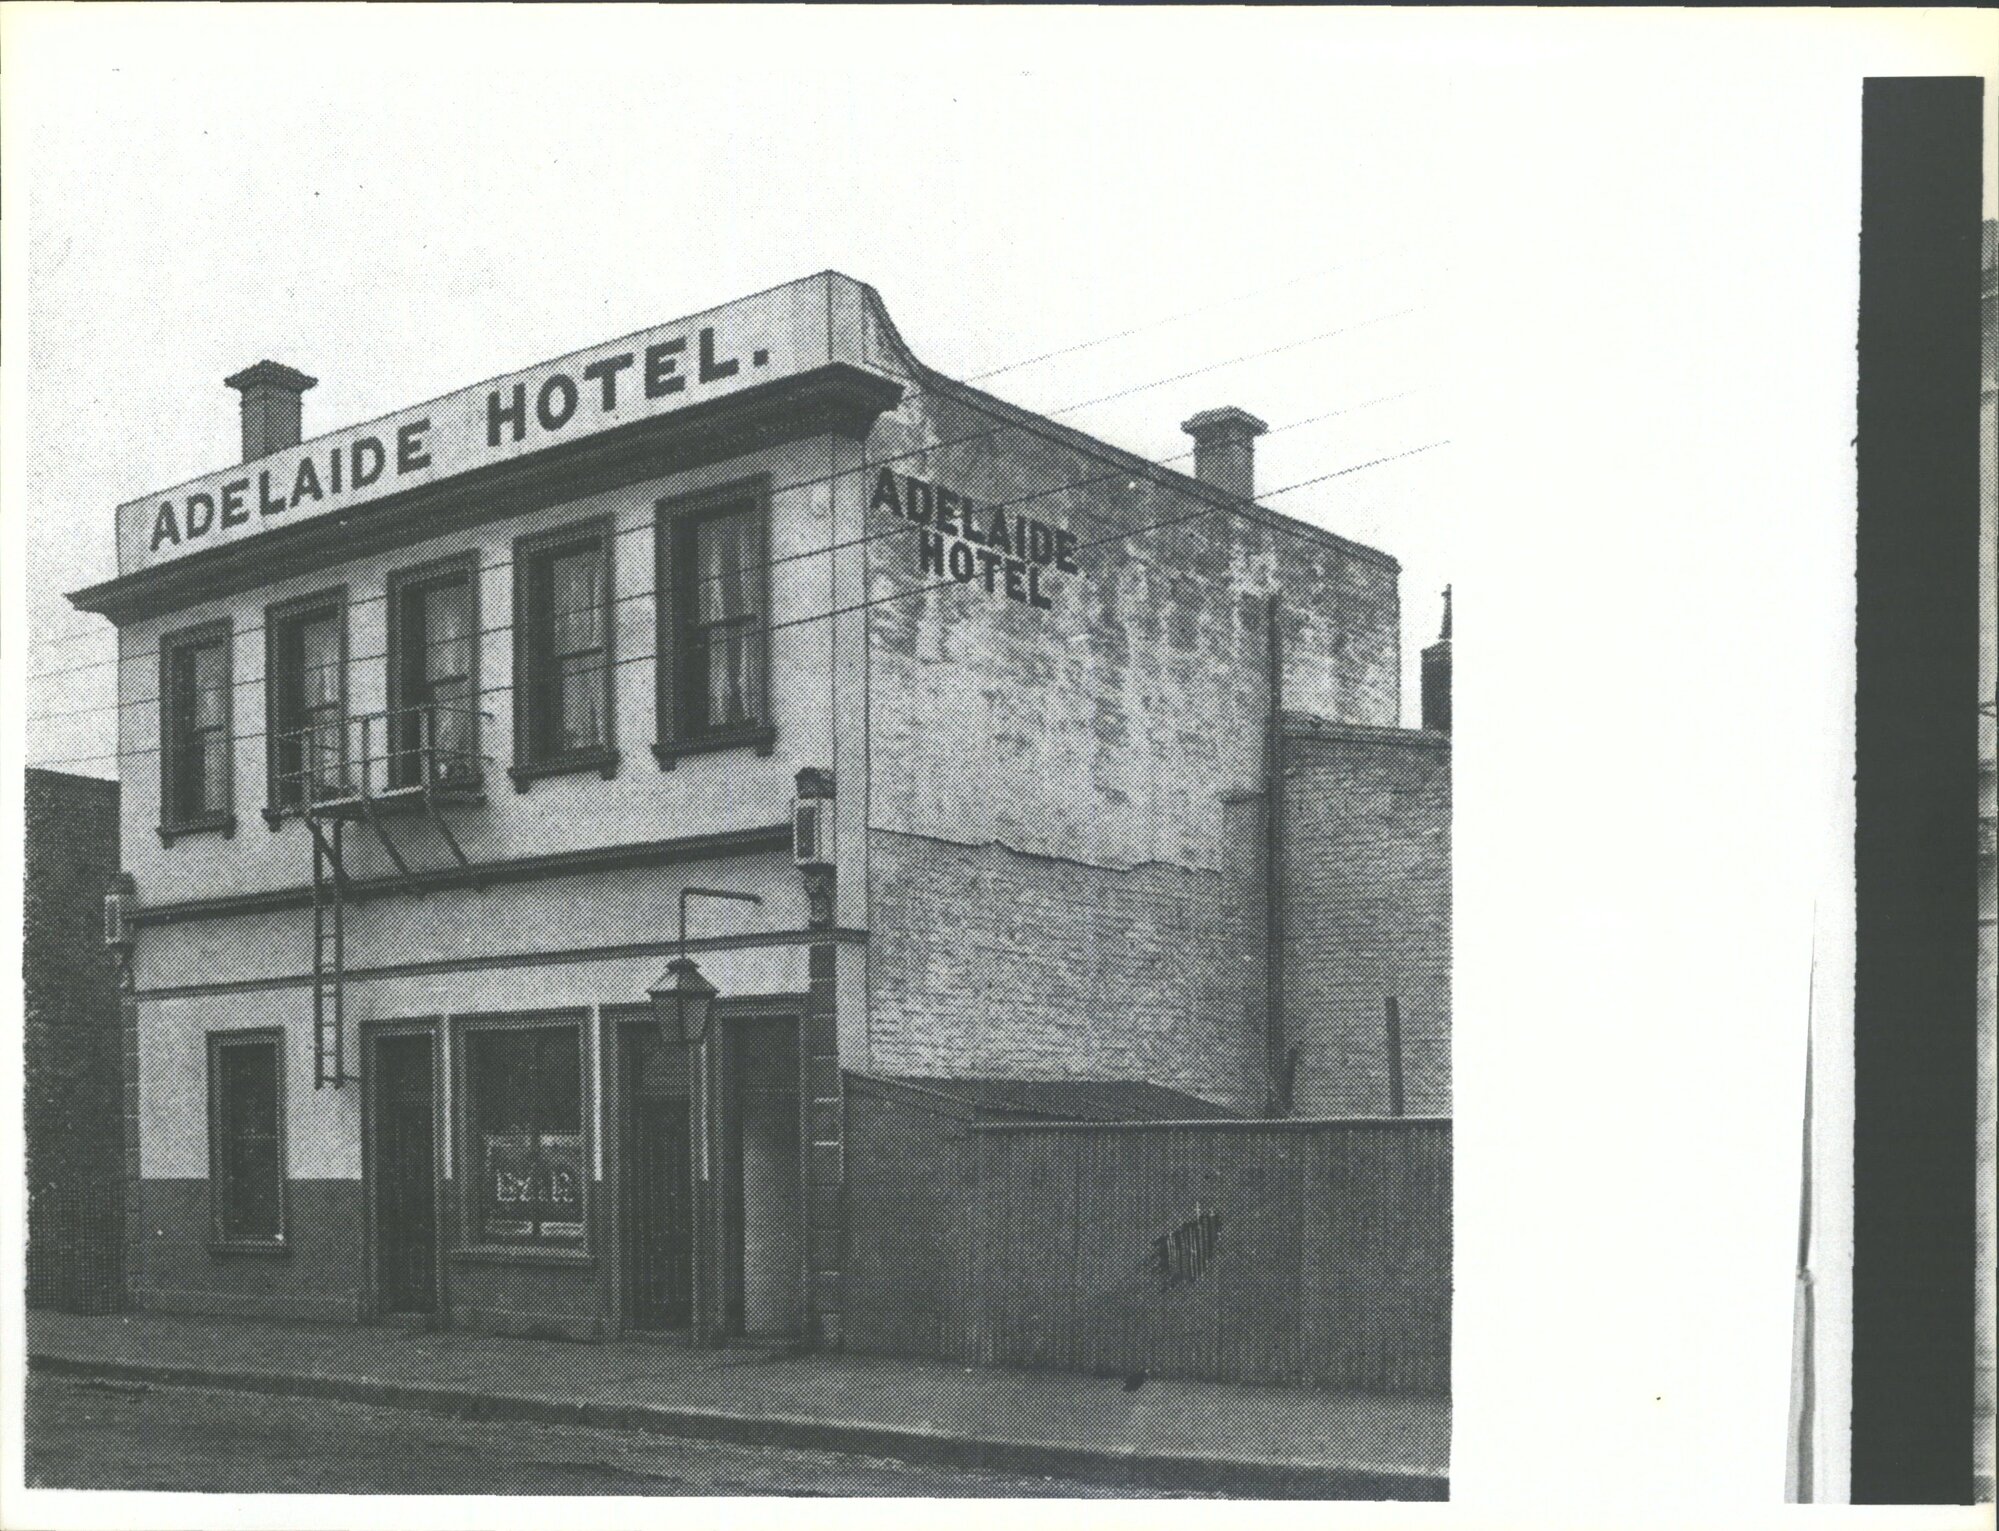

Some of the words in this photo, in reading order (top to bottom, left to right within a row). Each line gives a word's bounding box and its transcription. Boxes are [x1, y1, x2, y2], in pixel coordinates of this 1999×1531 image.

[151, 418, 431, 550] ADELAIDE
[487, 327, 769, 447] HOTEL.
[869, 466, 1078, 574] ADELAIDE
[920, 529, 1051, 610] HOTEL
